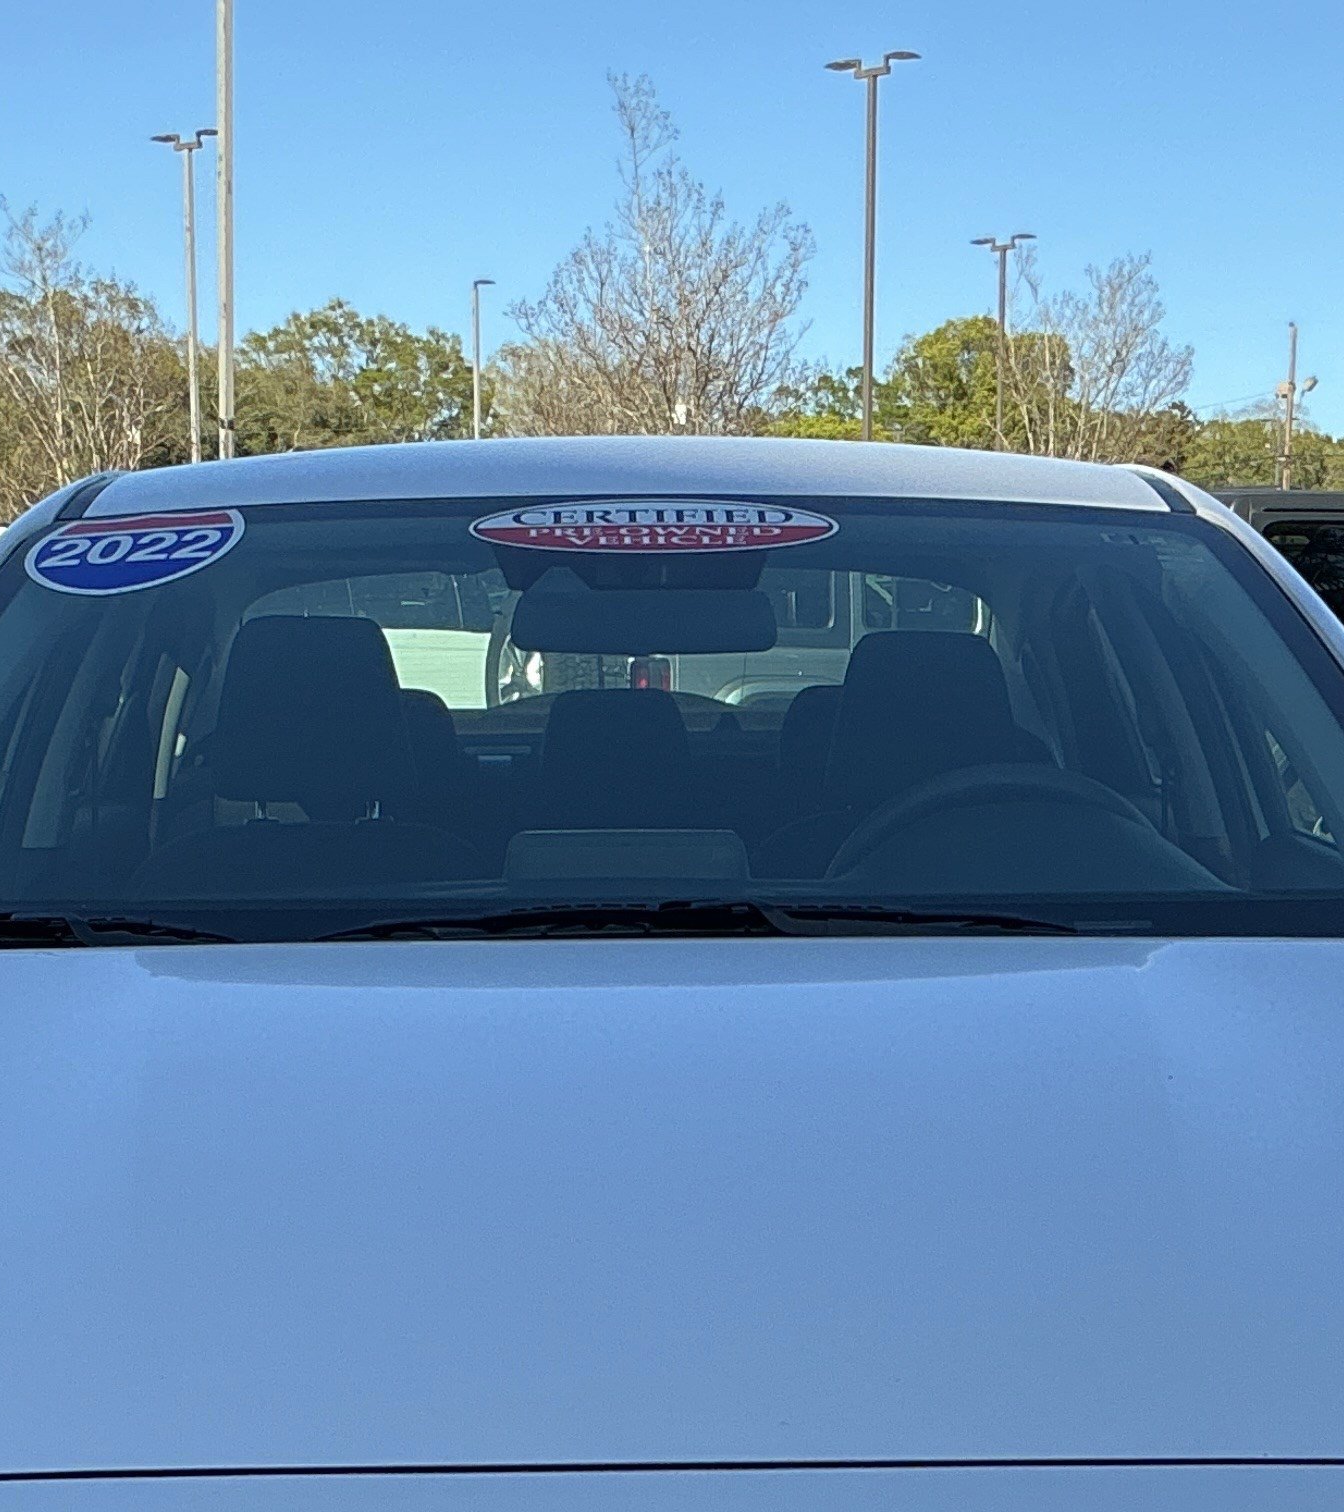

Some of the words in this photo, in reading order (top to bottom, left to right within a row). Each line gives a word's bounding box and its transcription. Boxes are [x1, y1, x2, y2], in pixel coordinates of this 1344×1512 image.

[512, 508, 794, 526] CERTIFIED
[528, 526, 783, 537] PRE-OWNED
[566, 535, 748, 546] VEHICLE
[37, 529, 222, 568] 2022
